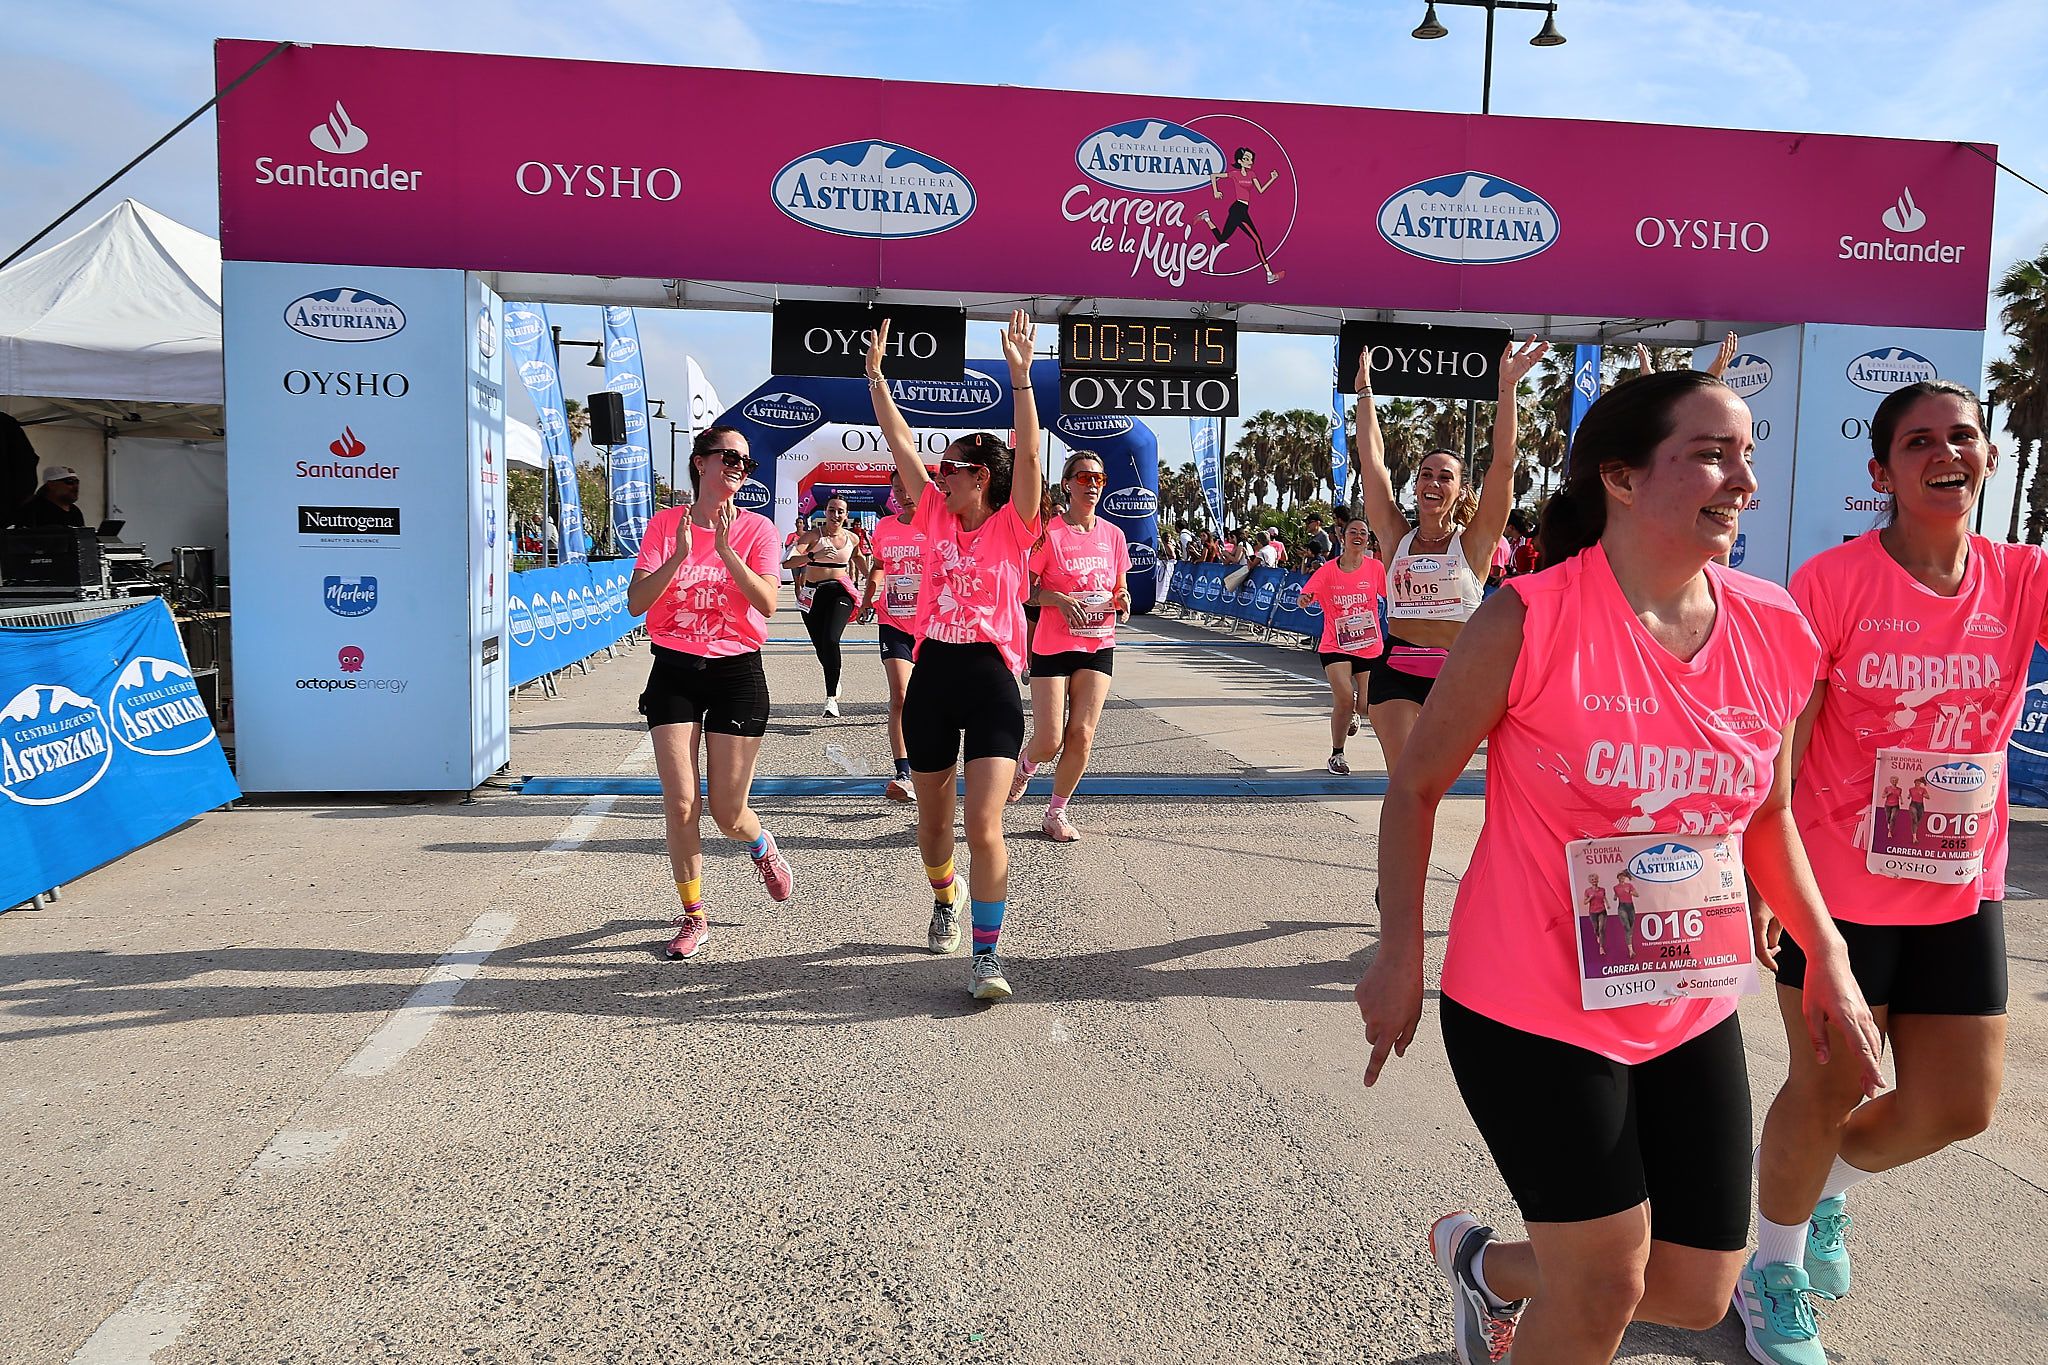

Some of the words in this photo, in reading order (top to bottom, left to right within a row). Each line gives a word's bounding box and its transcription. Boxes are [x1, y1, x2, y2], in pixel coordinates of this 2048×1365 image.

[1111, 142, 1158, 152] CENTRAL
[1162, 145, 1210, 154] LECHERA
[1087, 142, 1213, 176] ASTURIANA
[255, 157, 422, 191] Santander
[516, 160, 682, 201] OYSHO
[820, 171, 883, 184] CENTRAL
[890, 174, 954, 187] LECHERA
[787, 181, 961, 216] ASTURIANA
[1061, 184, 1185, 227] Carrera
[1420, 202, 1478, 213] CENTRAL
[1484, 205, 1540, 216] LECHERA
[1391, 203, 1545, 243] ASTURIANA
[1636, 216, 1769, 253] OYSHO
[1091, 226, 1114, 252] de
[1119, 226, 1136, 253] la
[1130, 225, 1230, 287] Mujer
[1838, 235, 1966, 264] Santander
[294, 306, 398, 330] ASTURIANA
[1073, 323, 1224, 364] 00:36:15
[1369, 345, 1488, 378] OYSHO
[1721, 372, 1768, 389] STURIANA
[1853, 363, 1930, 383] ASTURIANA
[283, 370, 409, 398] OYSHO
[892, 380, 993, 403] ASTURIANA
[1069, 377, 1230, 412] OYSHO
[748, 404, 815, 421] ASTURIANA
[1064, 418, 1129, 431] ASTURIANA
[841, 430, 950, 454] OYHO
[296, 461, 399, 479] Santander
[824, 462, 855, 472] Sports
[869, 463, 897, 472] Santa
[1844, 496, 1887, 511] Santa
[305, 512, 393, 531] Neutrogena
[882, 546, 920, 558] CARRERA
[1066, 556, 1108, 572] CARRERA
[327, 584, 375, 607] Marlene
[953, 573, 972, 597] DE
[1412, 583, 1439, 594] 016
[1333, 593, 1368, 605] CARRERA
[951, 606, 966, 627] LA
[1087, 612, 1104, 620] 016
[1858, 618, 1920, 633] OYSHO
[926, 622, 977, 644] MUJER
[1857, 652, 2000, 690] CARRERA
[127, 690, 165, 707] CENTRAL
[165, 681, 197, 697] LECHER
[296, 678, 356, 692] octopus
[357, 679, 408, 693] energy
[1583, 694, 1659, 715] OYSHO
[118, 694, 209, 742] ASTURIAN
[1929, 703, 1976, 750] DE
[15, 723, 58, 743] CENTRAL
[1584, 740, 1756, 796] CARRERA
[1891, 761, 1923, 772] SUMA
[1931, 770, 1983, 785] ASTURIANA
[1927, 813, 1978, 835] 016
[1886, 846, 1922, 857] CARRERA
[1925, 850, 1935, 858] DE
[1937, 850, 1947, 858] LA
[1949, 851, 1970, 860] MUJER
[1941, 839, 1967, 849] 2615
[1586, 853, 1624, 865] SUMA
[1635, 859, 1699, 875] ASTURIANA
[1885, 860, 1937, 875] OYSHO
[1640, 909, 1704, 941] 016
[1661, 944, 1690, 958] 2614
[1602, 964, 1640, 975] CARRERA
[1642, 962, 1654, 971] DE
[1656, 961, 1667, 970] LA
[1669, 959, 1697, 969] MUJER
[1703, 954, 1738, 966] VALENCIA
[1605, 979, 1656, 998] OYSHO
[1690, 976, 1738, 989] Santander
